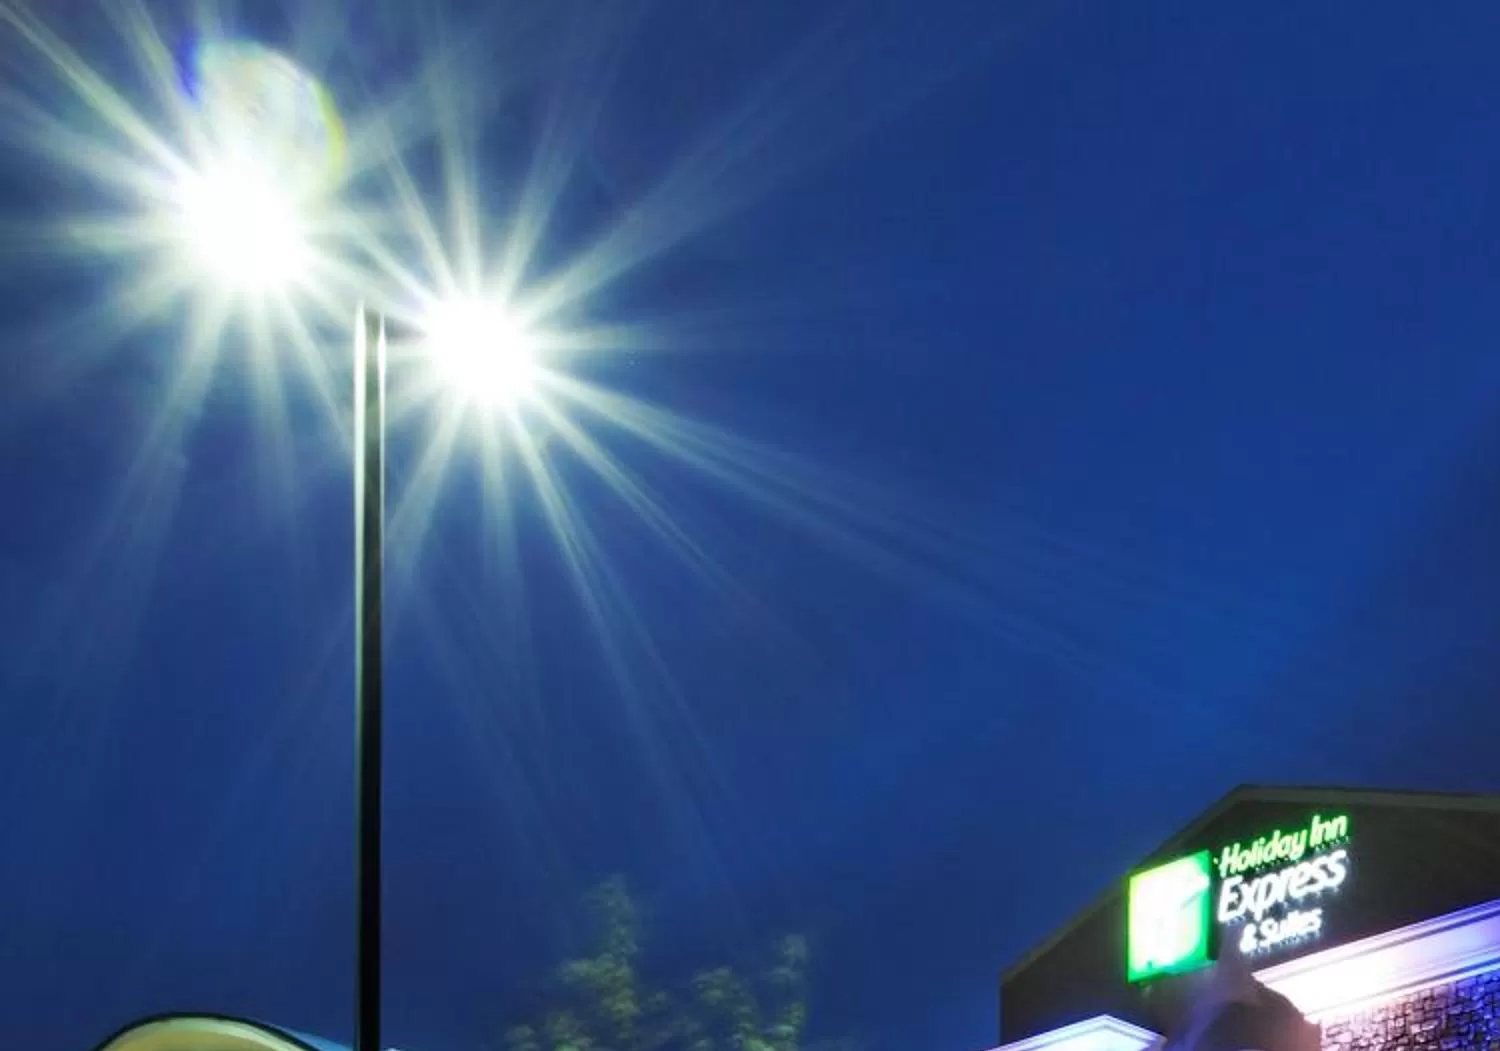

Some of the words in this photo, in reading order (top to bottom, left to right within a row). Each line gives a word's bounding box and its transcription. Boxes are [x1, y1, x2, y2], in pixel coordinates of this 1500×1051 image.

[1219, 829, 1308, 878] Holiday
[1309, 815, 1348, 848] Inn
[1217, 849, 1347, 923] Express
[1239, 923, 1257, 954] &
[1258, 908, 1323, 948] Suites
